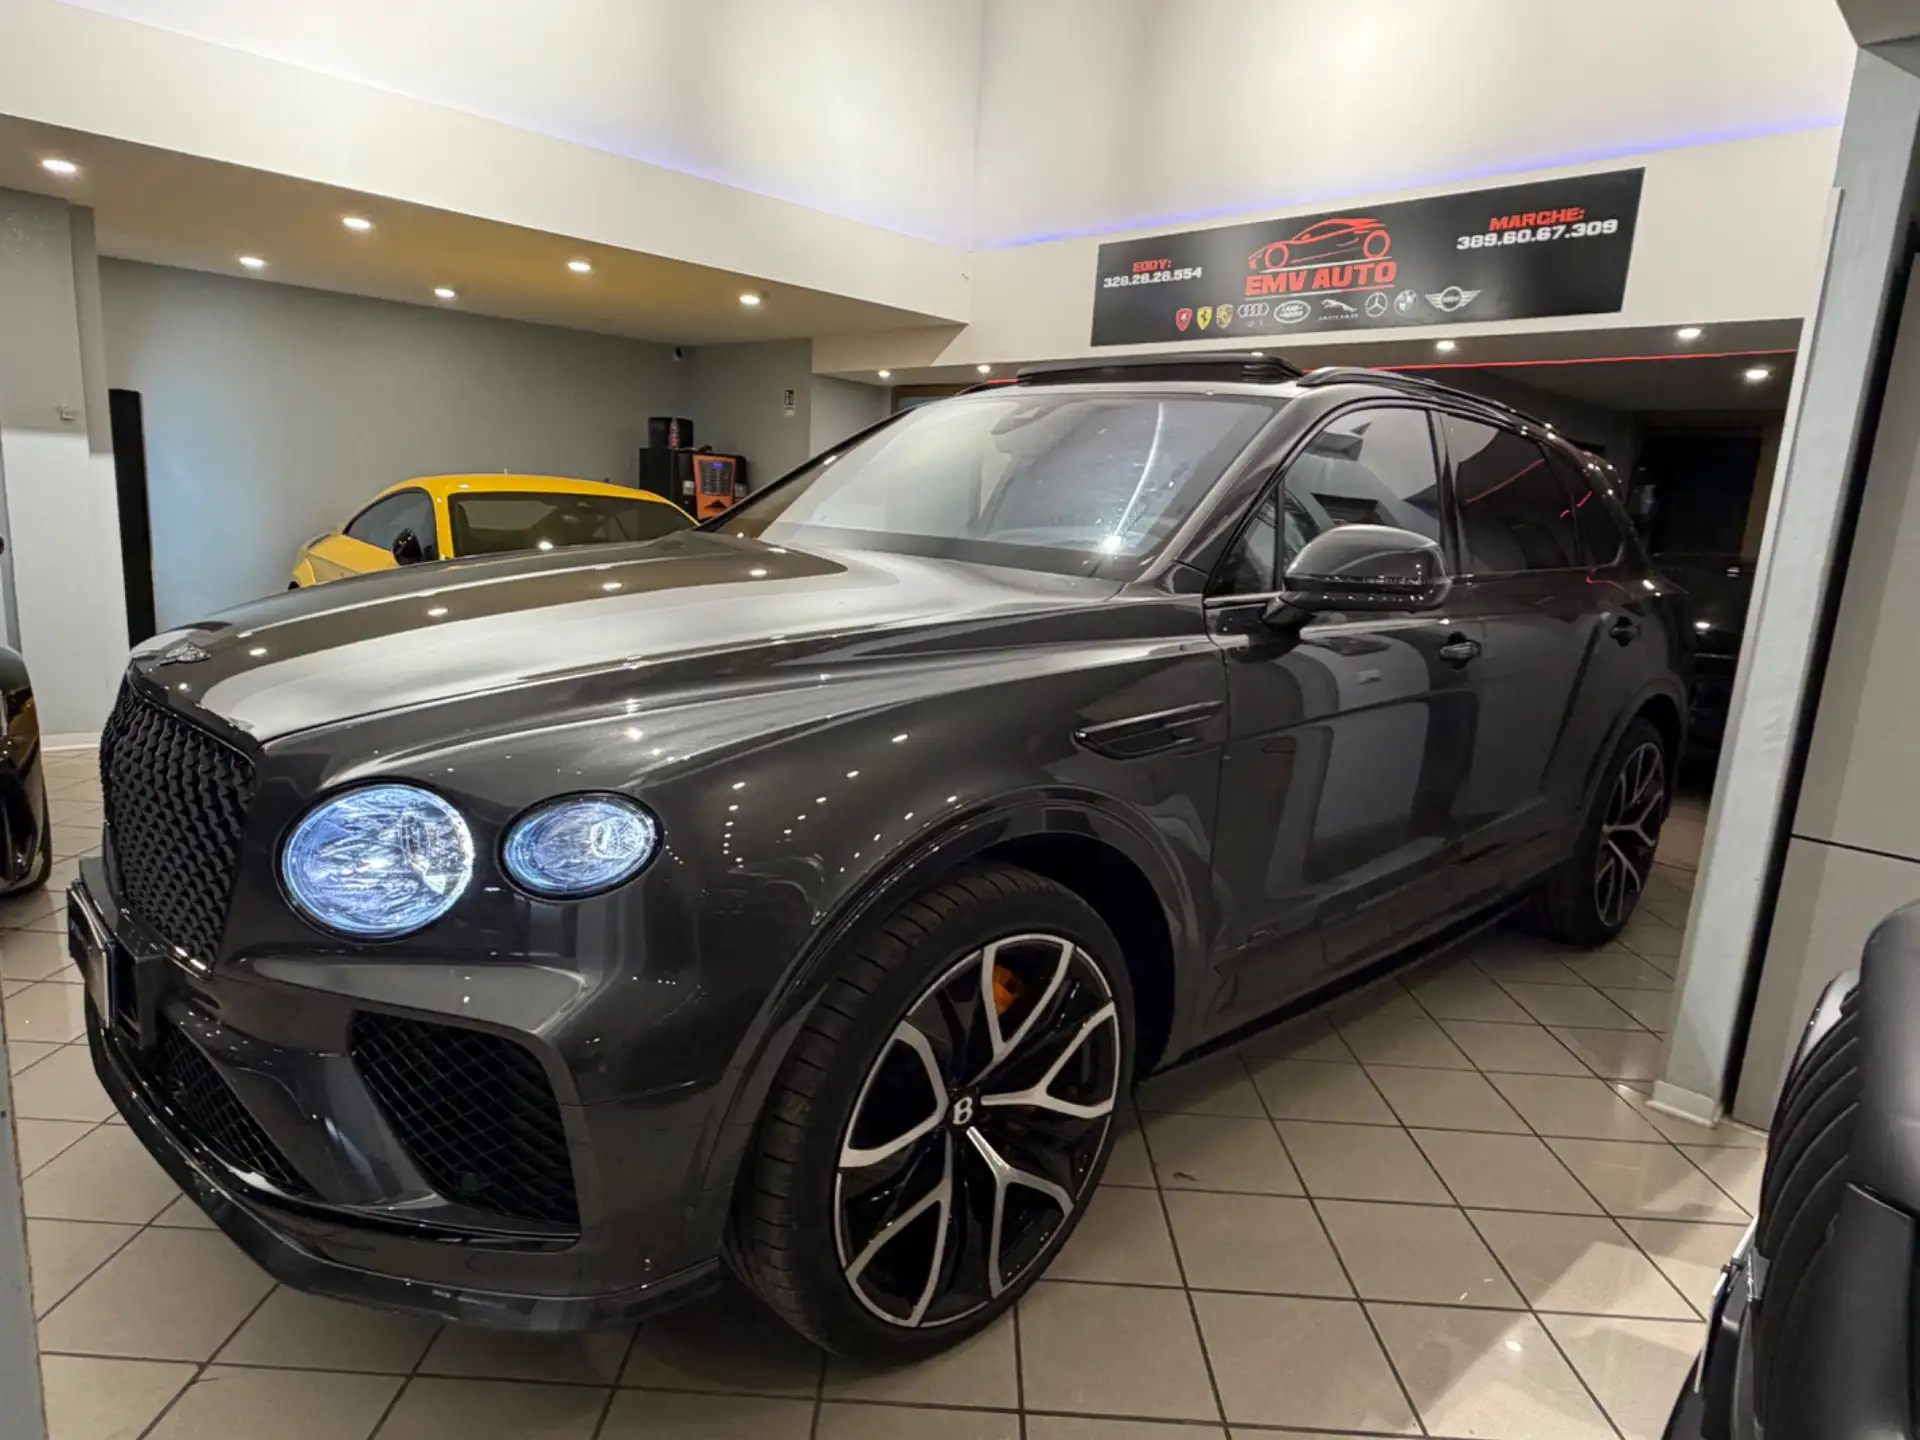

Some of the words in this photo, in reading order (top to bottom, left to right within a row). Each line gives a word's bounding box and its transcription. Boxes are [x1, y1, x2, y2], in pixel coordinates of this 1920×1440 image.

[1456, 214, 1619, 250] 389.60.67.309
[1488, 207, 1585, 231] MARCHE:
[1132, 258, 1172, 273] EDDY:
[1245, 270, 1308, 297] EMV
[1311, 261, 1397, 289] AUTO
[952, 1096, 973, 1126] B
